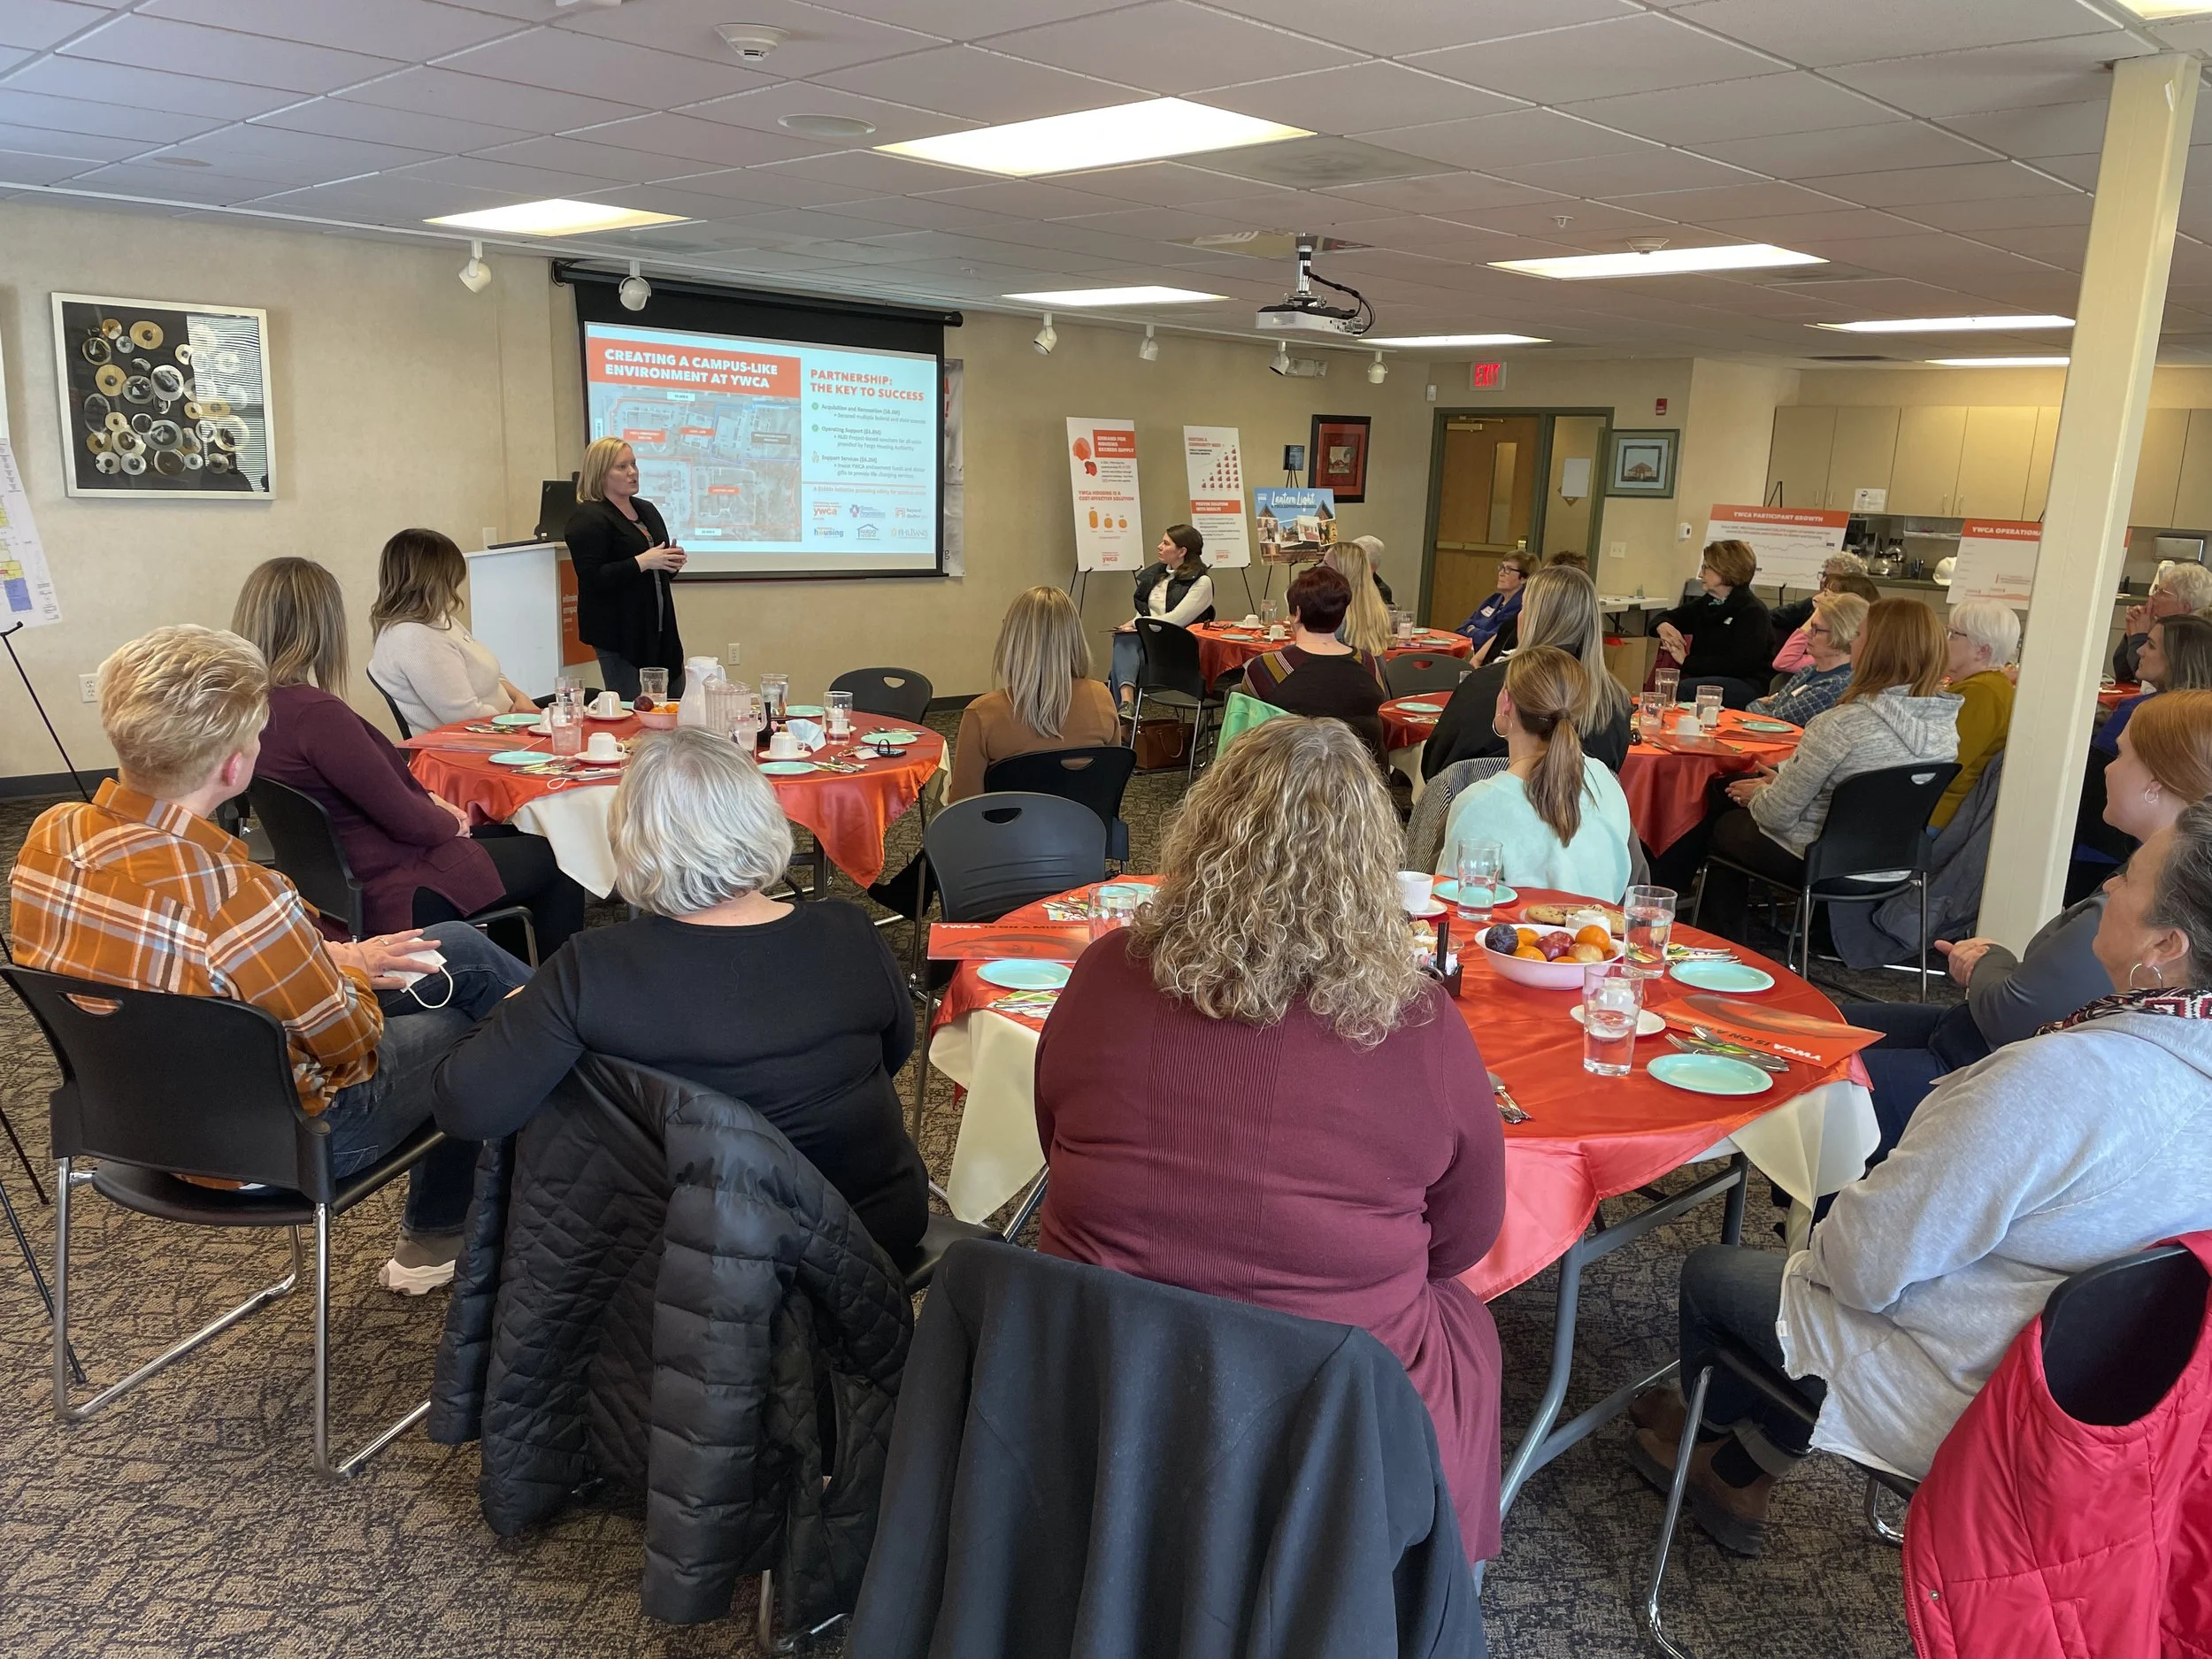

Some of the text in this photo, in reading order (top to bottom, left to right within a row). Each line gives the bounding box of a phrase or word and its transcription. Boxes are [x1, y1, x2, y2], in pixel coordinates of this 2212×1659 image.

[604, 348, 778, 375] CREATING A CAMPUS-LIKE
[605, 364, 770, 388] ENVIRONMENT AT YWCA
[810, 369, 893, 386] PARTNERSHIP:
[1475, 364, 1501, 387] EXIT
[810, 382, 925, 402] THE KEY TO SUCCESS
[1271, 491, 1297, 506] Lantern
[1297, 491, 1316, 510] Light
[813, 508, 837, 517] ywca
[1728, 1032, 1753, 1041] ON
[1773, 1043, 1821, 1061] YWCA
